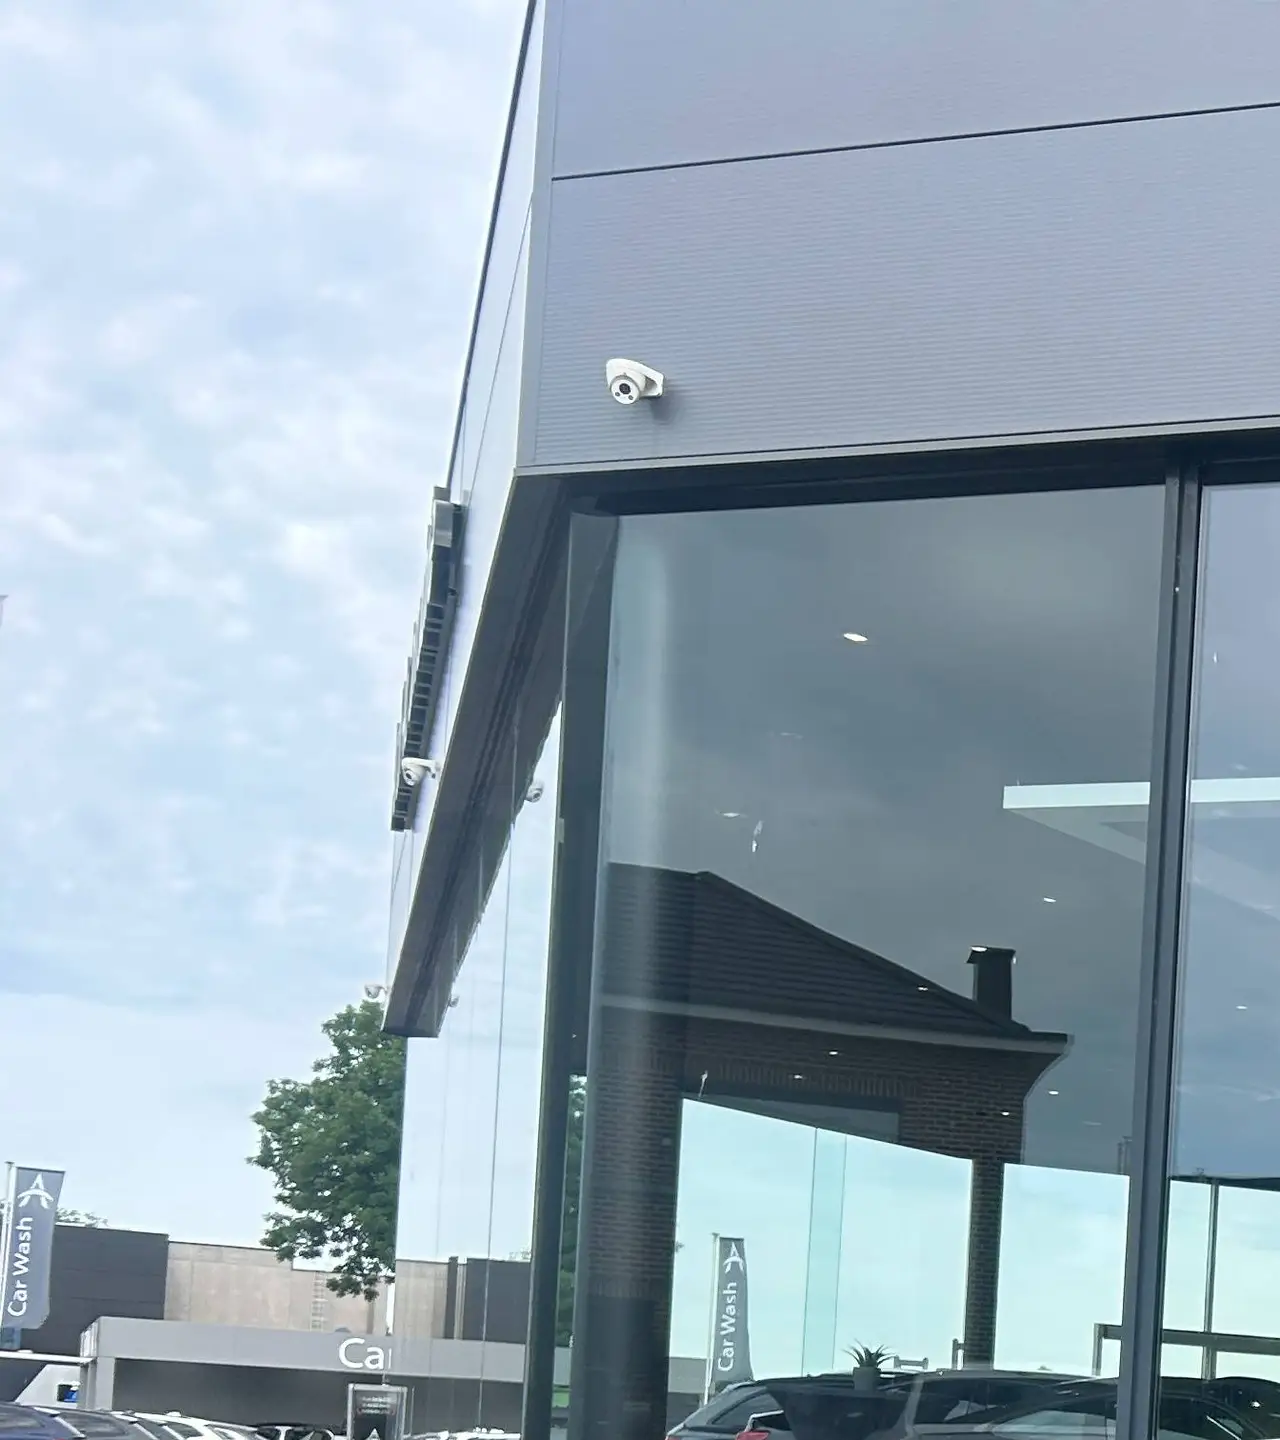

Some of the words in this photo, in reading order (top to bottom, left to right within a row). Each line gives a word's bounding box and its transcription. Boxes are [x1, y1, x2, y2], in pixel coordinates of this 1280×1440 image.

[12, 1217, 34, 1276] Wash
[7, 1280, 28, 1317] Car
[720, 1281, 738, 1336] Wash
[717, 1338, 734, 1372] Car
